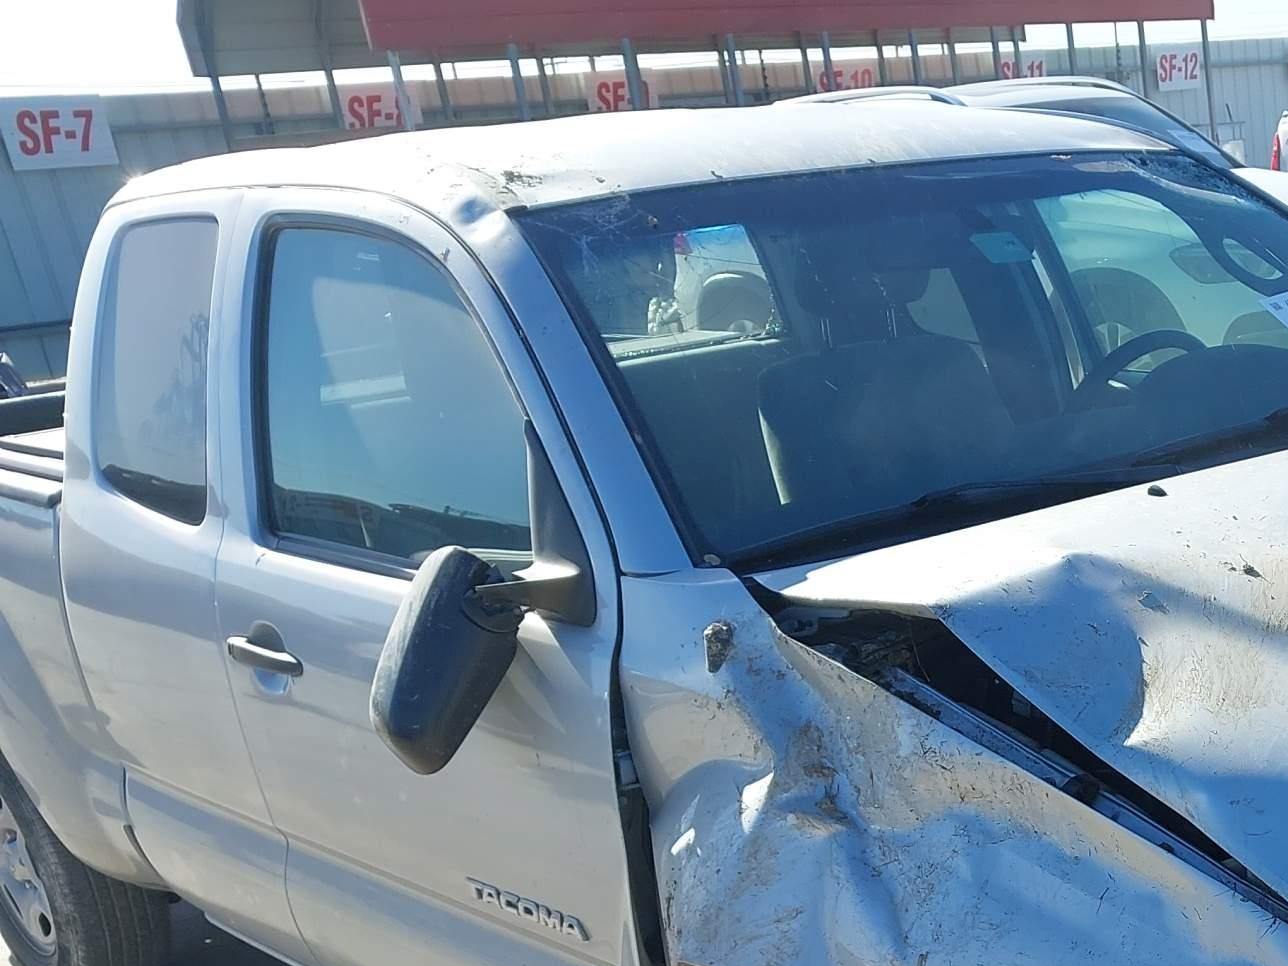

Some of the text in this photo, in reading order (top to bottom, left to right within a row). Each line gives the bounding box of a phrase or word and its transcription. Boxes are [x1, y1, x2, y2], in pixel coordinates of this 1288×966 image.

[1159, 52, 1198, 82] SF-12
[16, 109, 93, 156] SF-7
[466, 876, 591, 942] TACOMA
